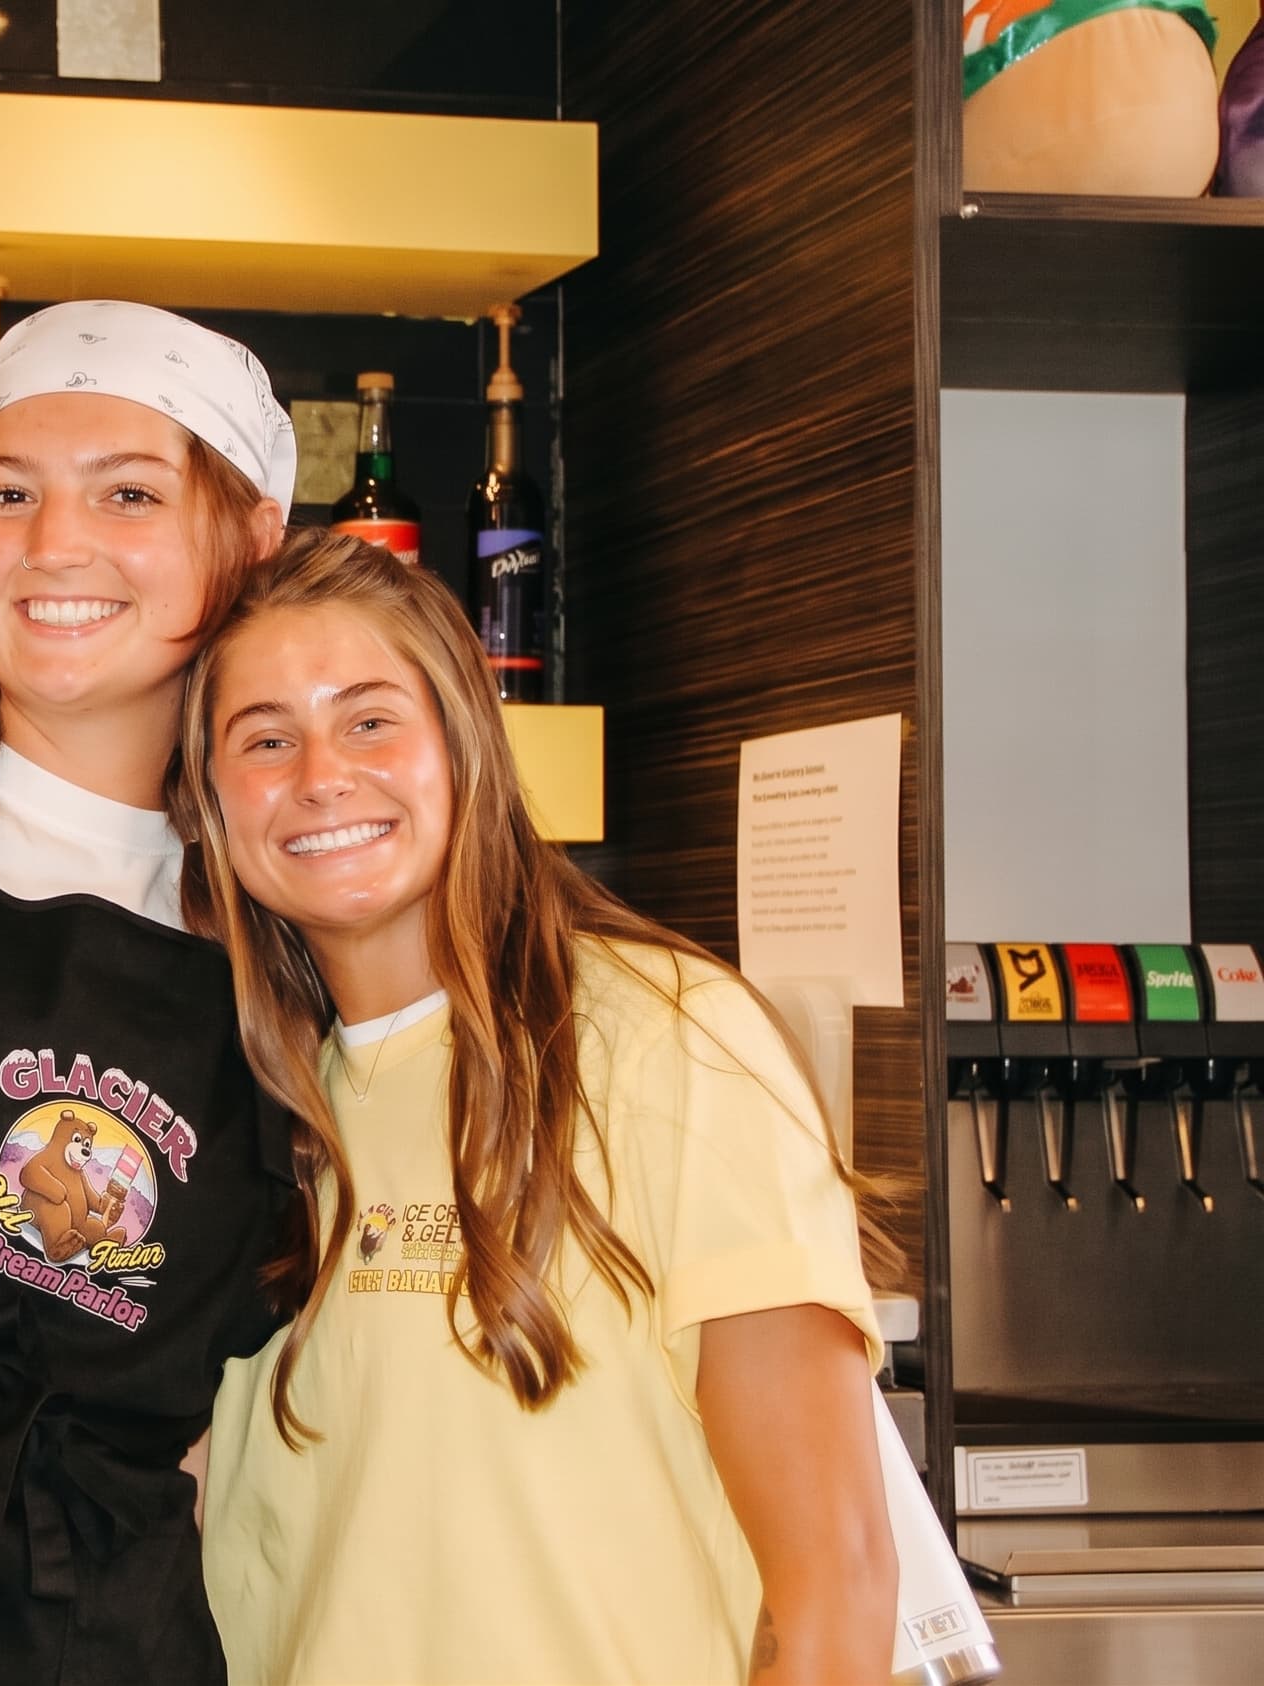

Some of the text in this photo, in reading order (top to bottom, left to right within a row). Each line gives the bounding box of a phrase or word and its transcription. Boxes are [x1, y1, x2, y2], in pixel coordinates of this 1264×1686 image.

[401, 1203, 431, 1222] ICE
[401, 1223, 415, 1242] &
[57, 1269, 147, 1332] Parlor
